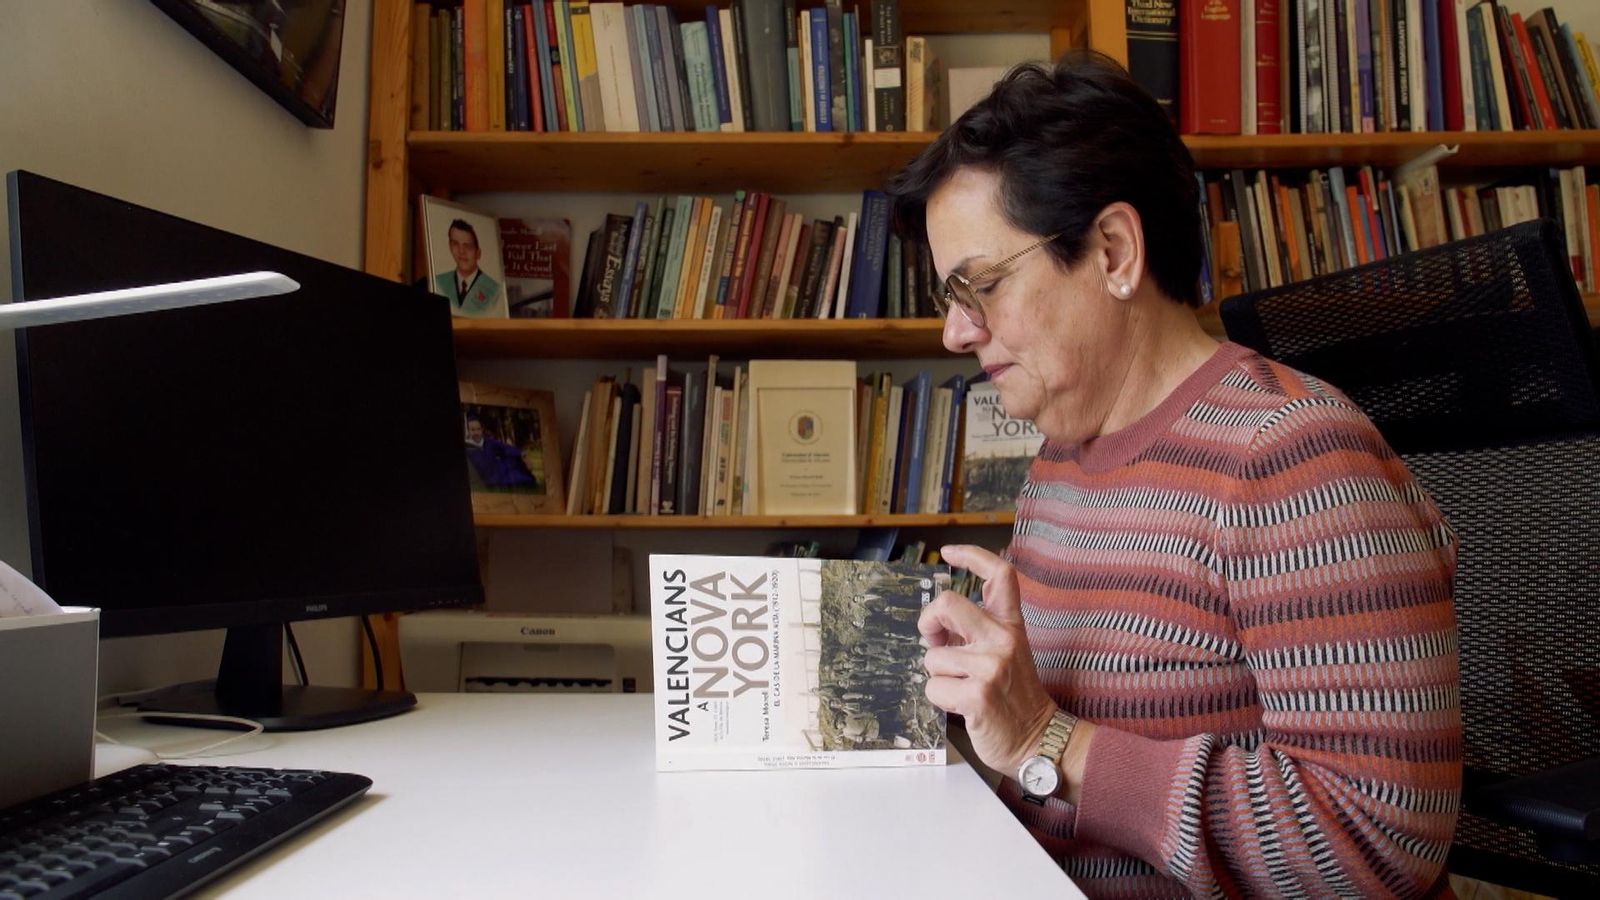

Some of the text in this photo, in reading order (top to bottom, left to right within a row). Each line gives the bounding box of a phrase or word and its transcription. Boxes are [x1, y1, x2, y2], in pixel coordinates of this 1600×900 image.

[1128, 7, 1176, 16] International
[1132, 15, 1172, 25] Dictionary
[520, 626, 556, 636] Canon
[690, 571, 729, 699] NOVA
[730, 572, 770, 698] YORK
[663, 568, 690, 742] VALENCIANS
[773, 671, 780, 680] DE
[697, 701, 709, 712] A
